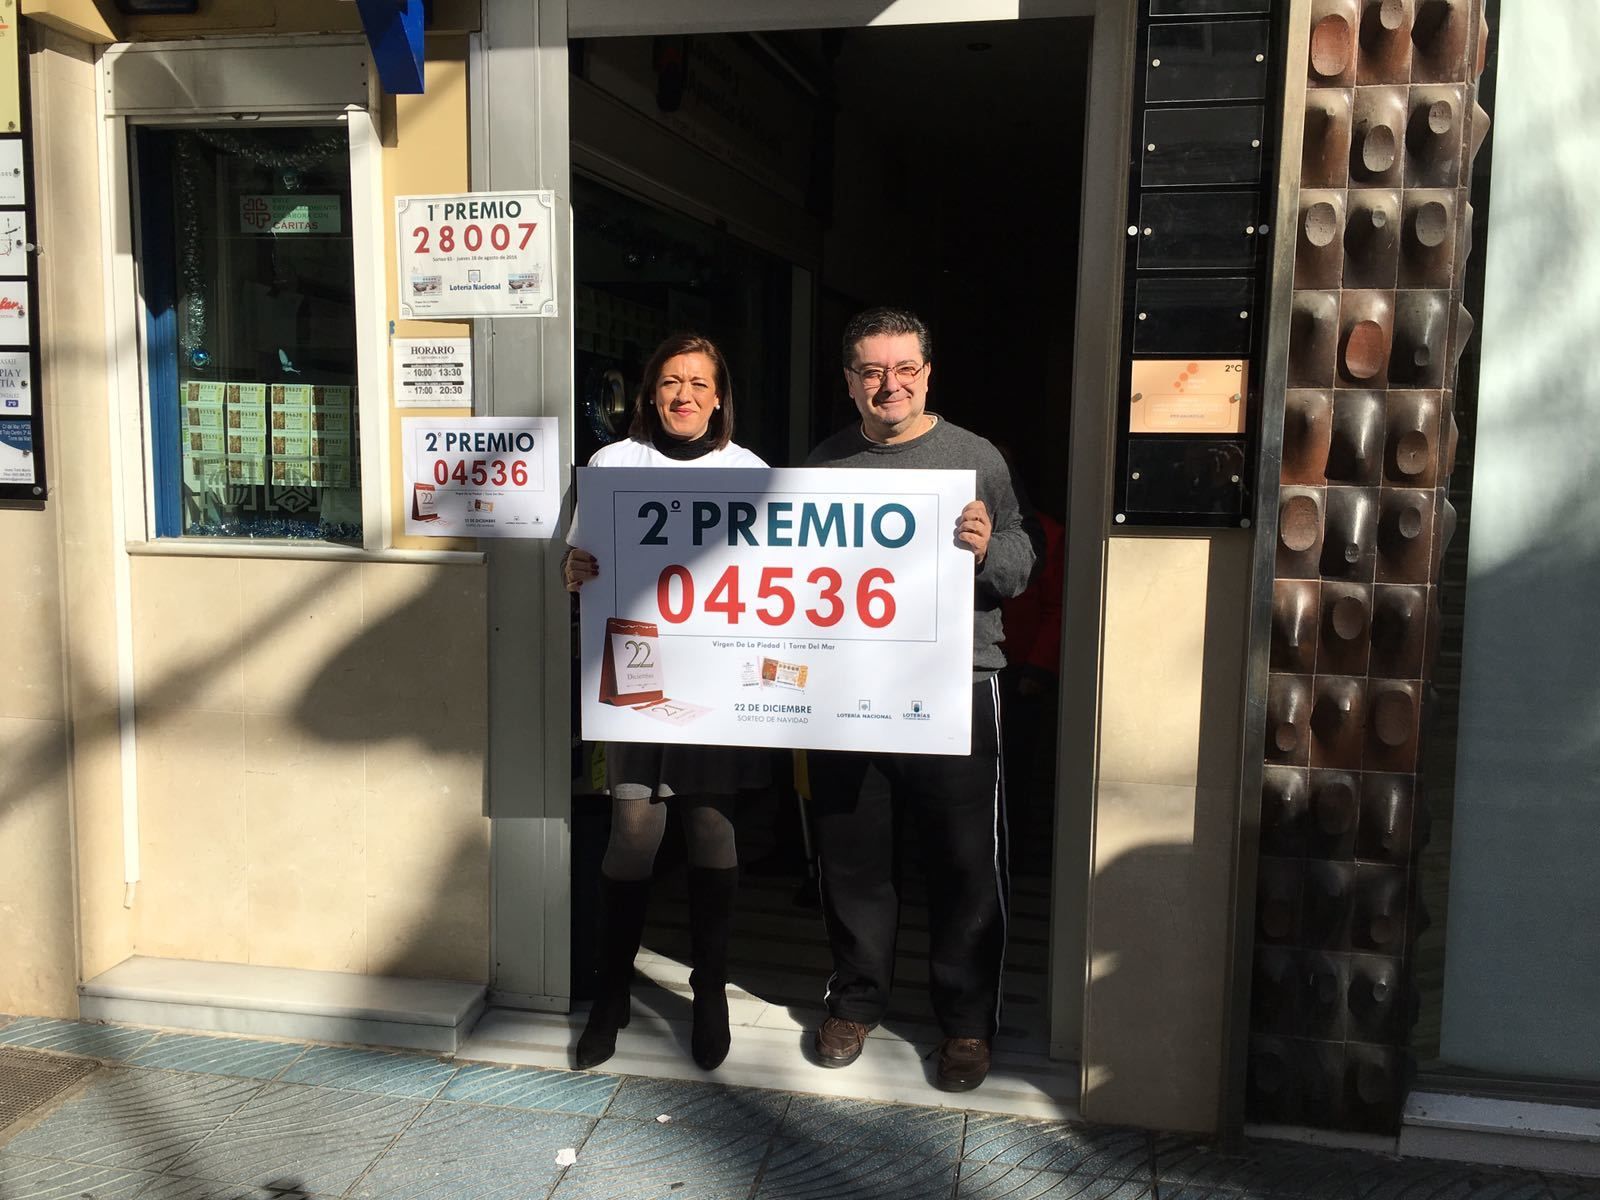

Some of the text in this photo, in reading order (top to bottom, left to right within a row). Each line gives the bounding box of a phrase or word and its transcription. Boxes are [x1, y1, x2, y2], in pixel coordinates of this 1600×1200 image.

[444, 200, 522, 220] PREMIO
[412, 222, 538, 254] 28007
[411, 346, 454, 355] HORARIO
[414, 368, 462, 377] 10:00 13:30
[414, 386, 463, 394] 17:00 20:30
[446, 432, 534, 452] PREMIO
[434, 459, 528, 486] 04536
[692, 502, 916, 549] PREMIO
[656, 564, 896, 629] 04536
[624, 640, 654, 668] 22
[712, 640, 734, 649] Virgen
[789, 642, 806, 650] Torre
[734, 703, 812, 714] 22 DE DICIEMBRE
[766, 715, 775, 723] DE
[777, 716, 809, 724] NAVIDAD
